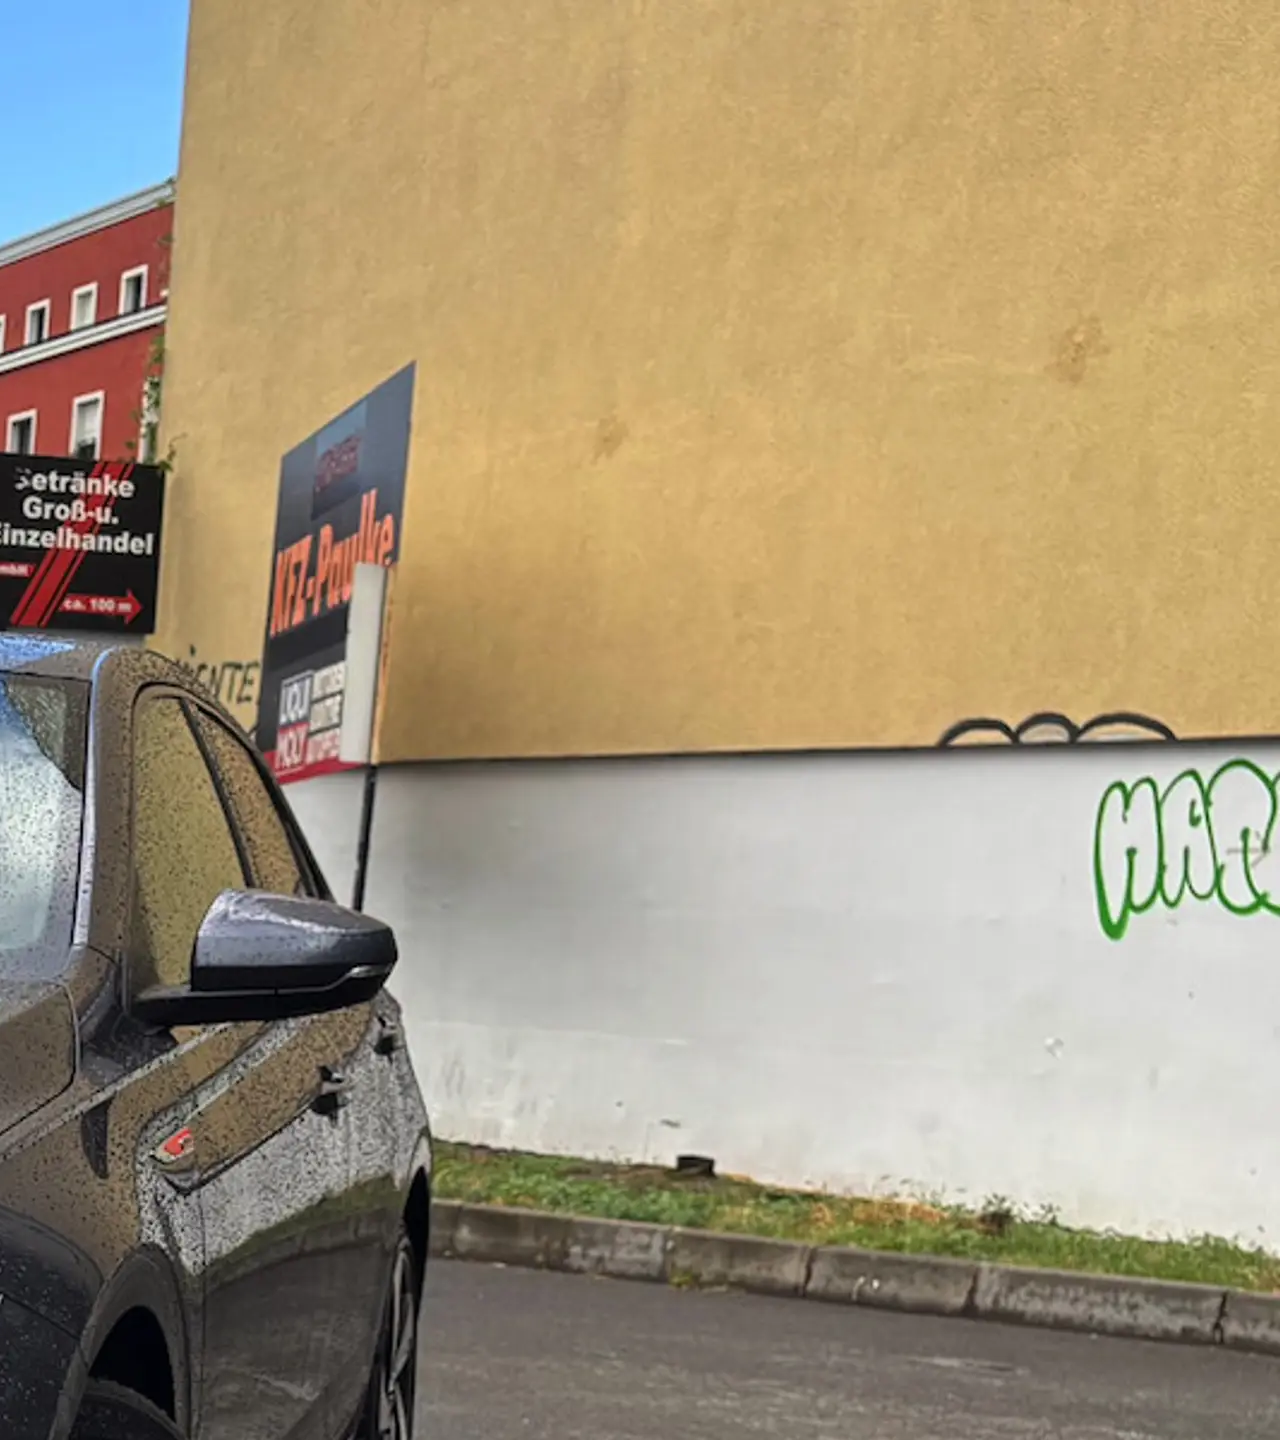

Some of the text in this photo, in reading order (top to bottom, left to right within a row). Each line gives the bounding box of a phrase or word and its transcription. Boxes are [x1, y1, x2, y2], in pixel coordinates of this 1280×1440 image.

[63, 597, 132, 613] ca. 100 m
